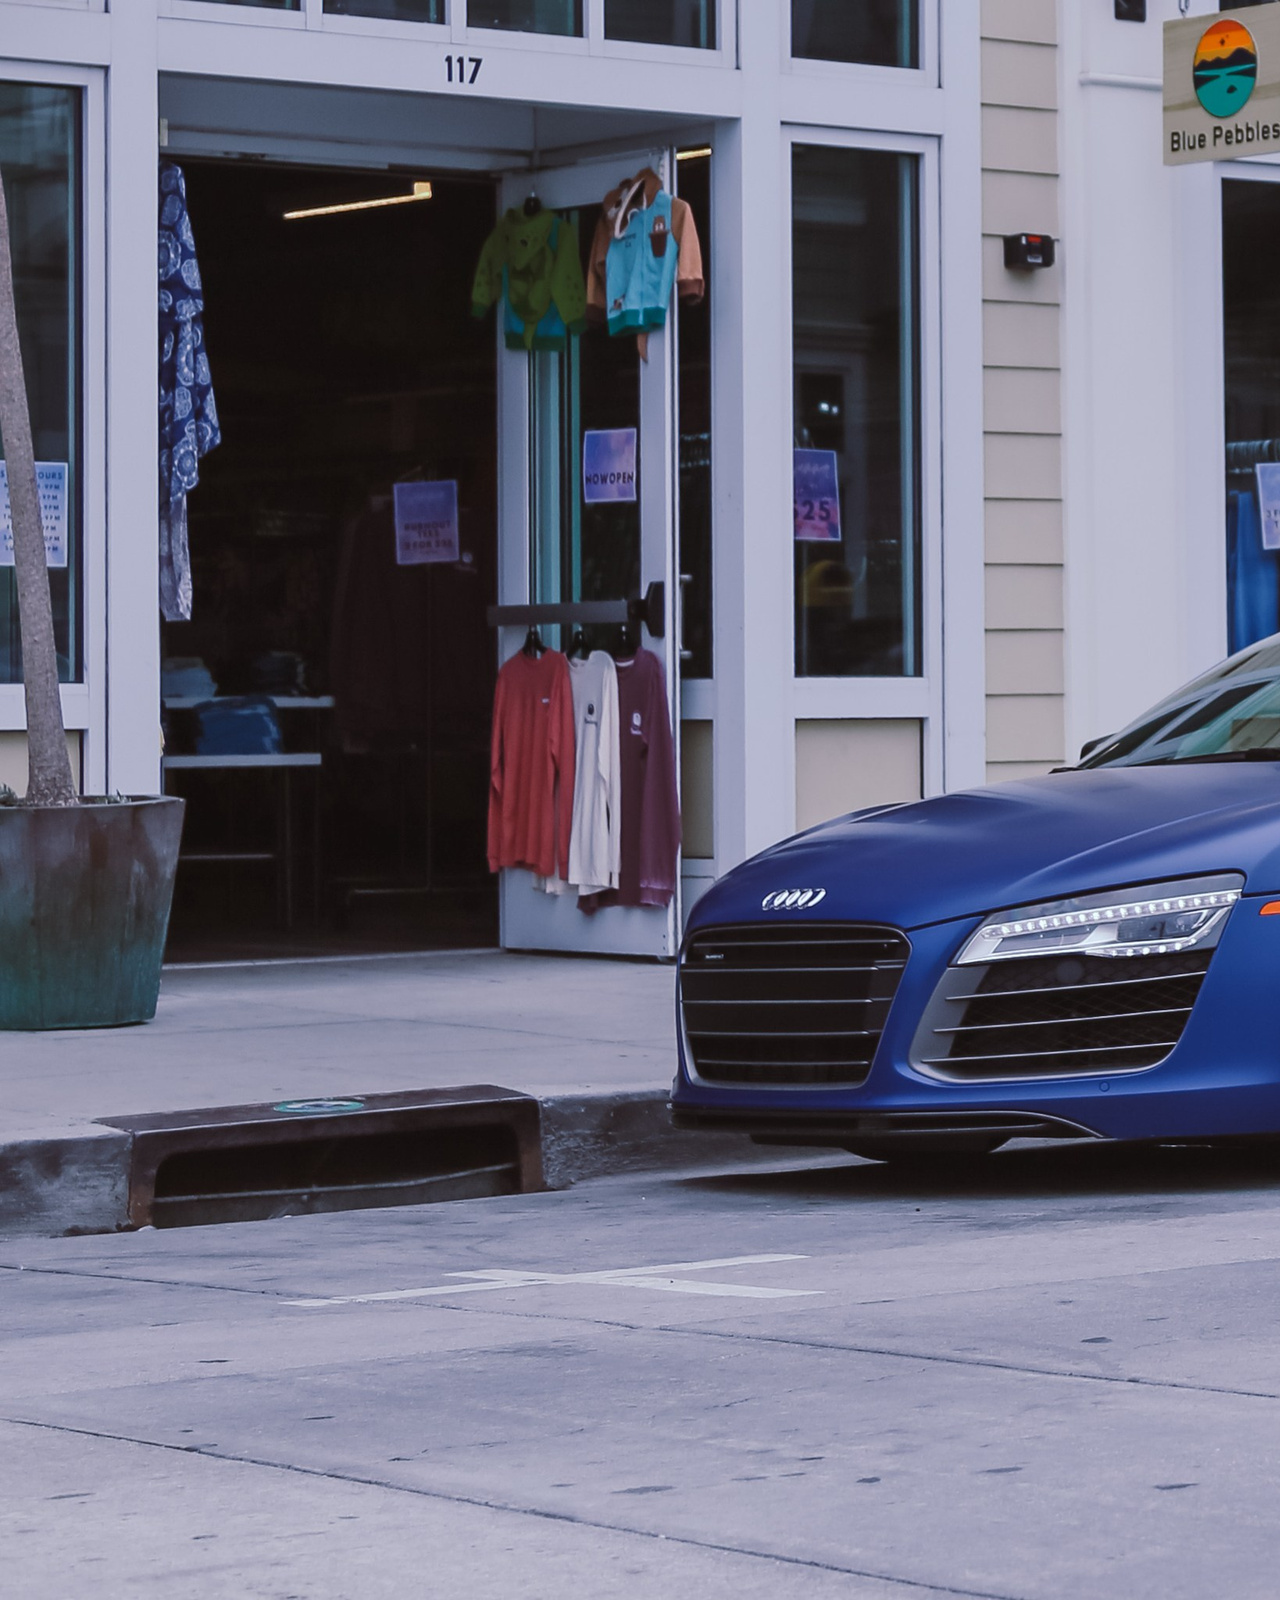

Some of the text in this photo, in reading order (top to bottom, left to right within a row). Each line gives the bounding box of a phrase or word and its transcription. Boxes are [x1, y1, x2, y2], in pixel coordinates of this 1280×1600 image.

[445, 55, 483, 84] 117
[1171, 121, 1280, 152] Blue Pebbles
[38, 471, 63, 480] OURS
[1266, 509, 1272, 518] 3
